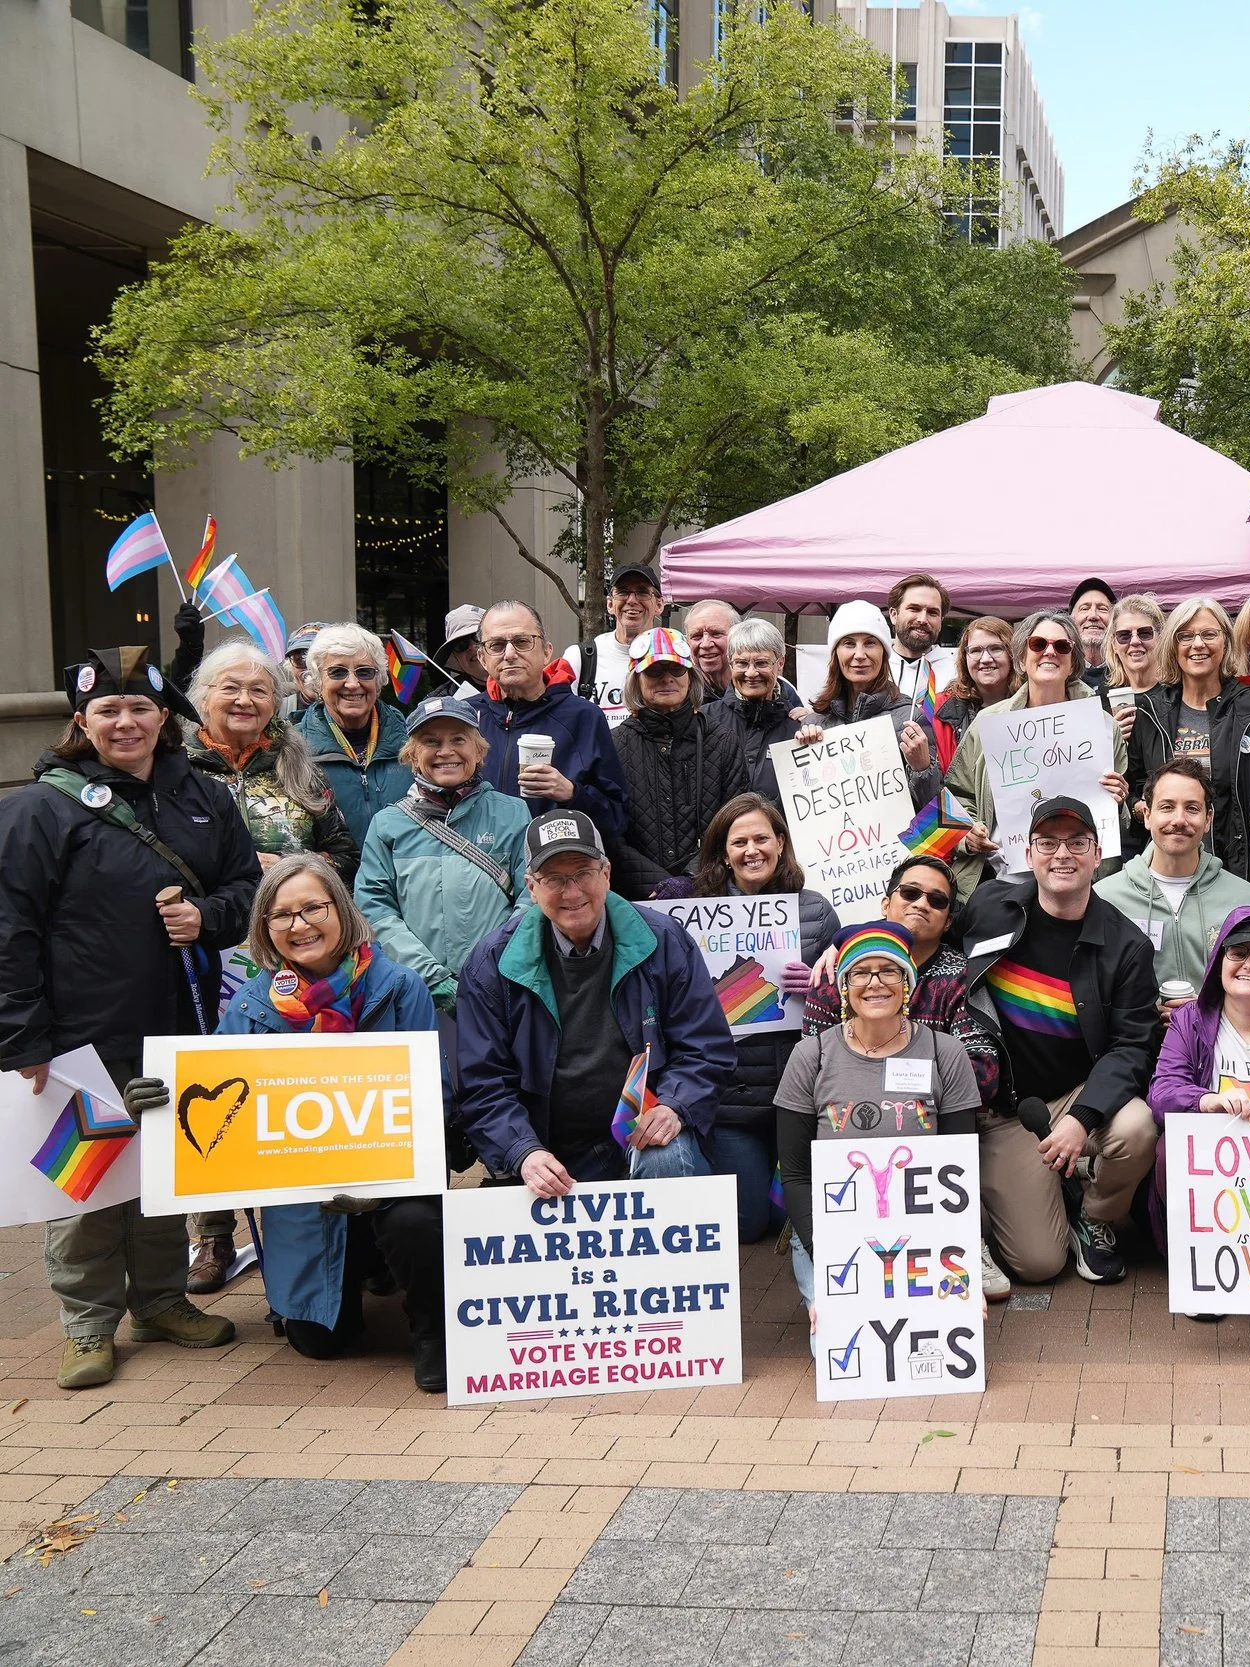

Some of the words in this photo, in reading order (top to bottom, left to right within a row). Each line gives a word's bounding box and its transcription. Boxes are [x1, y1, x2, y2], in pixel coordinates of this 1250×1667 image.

[1007, 714, 1066, 743] VOTE
[791, 731, 867, 768] EVERY
[992, 746, 1040, 783] YES
[1042, 746, 1072, 767] ON
[1077, 740, 1094, 761] 2
[802, 750, 874, 787] LOVE
[793, 768, 904, 821] DESERVES
[540, 820, 575, 832] VIRGINIA
[843, 812, 855, 829] A
[817, 823, 881, 856] VOW
[821, 850, 901, 881] MARRIAGE
[668, 903, 734, 931] SAYS
[743, 900, 788, 928] YES
[735, 928, 800, 953] EQUALITY
[255, 1075, 317, 1087] STANDING
[320, 1075, 338, 1085] ON
[341, 1074, 364, 1084] THE
[367, 1074, 392, 1083] SIDE
[395, 1074, 410, 1082] OF
[255, 1088, 412, 1142] LOVE
[256, 1141, 413, 1156] www.StandingontheSideofLove.org
[1234, 1177, 1246, 1188] IS
[531, 1191, 655, 1226] CIVIL
[463, 1223, 721, 1267] MARRIAGE
[1237, 1233, 1250, 1244] IS
[571, 1266, 594, 1285] is
[603, 1269, 618, 1283] a
[864, 1235, 970, 1300] YES
[457, 1293, 578, 1327] CIVIL
[593, 1283, 730, 1318] RIGHT
[509, 1344, 576, 1366] VOTE
[582, 1340, 627, 1360] YES
[634, 1337, 682, 1356] FOR
[914, 1360, 938, 1374] VOTE
[466, 1367, 600, 1394] MARRIAGE
[607, 1358, 725, 1383] EQUALITY
